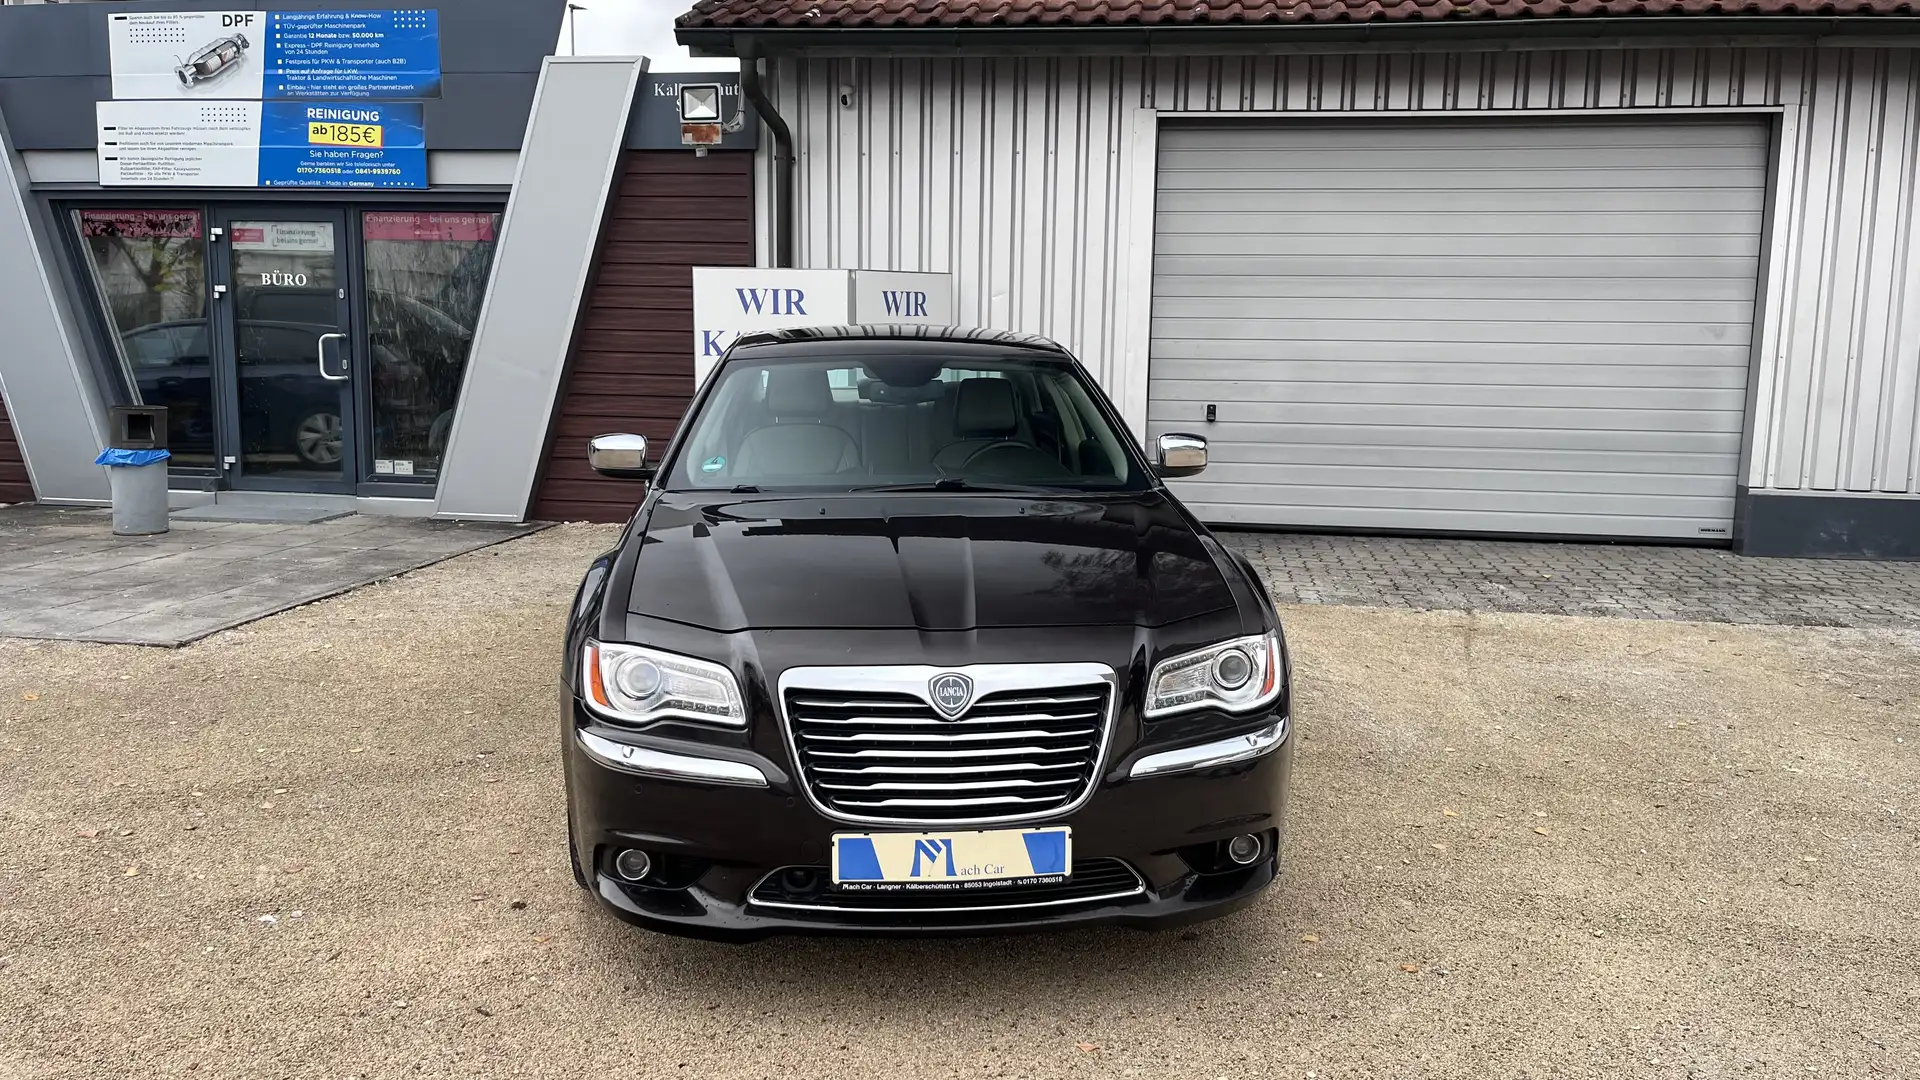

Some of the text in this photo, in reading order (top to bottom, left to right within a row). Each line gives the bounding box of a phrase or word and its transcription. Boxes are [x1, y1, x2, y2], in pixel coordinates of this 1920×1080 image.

[222, 14, 254, 27] DPF
[307, 108, 379, 121] REINIGUNG
[312, 125, 375, 143] ab 185€
[310, 150, 383, 159] Sie haben Fragen?
[261, 270, 307, 286] BÜRO
[736, 288, 808, 315] WIR
[882, 291, 928, 317] WIR
[940, 687, 963, 696] LANCIA
[984, 863, 1005, 875] Car
